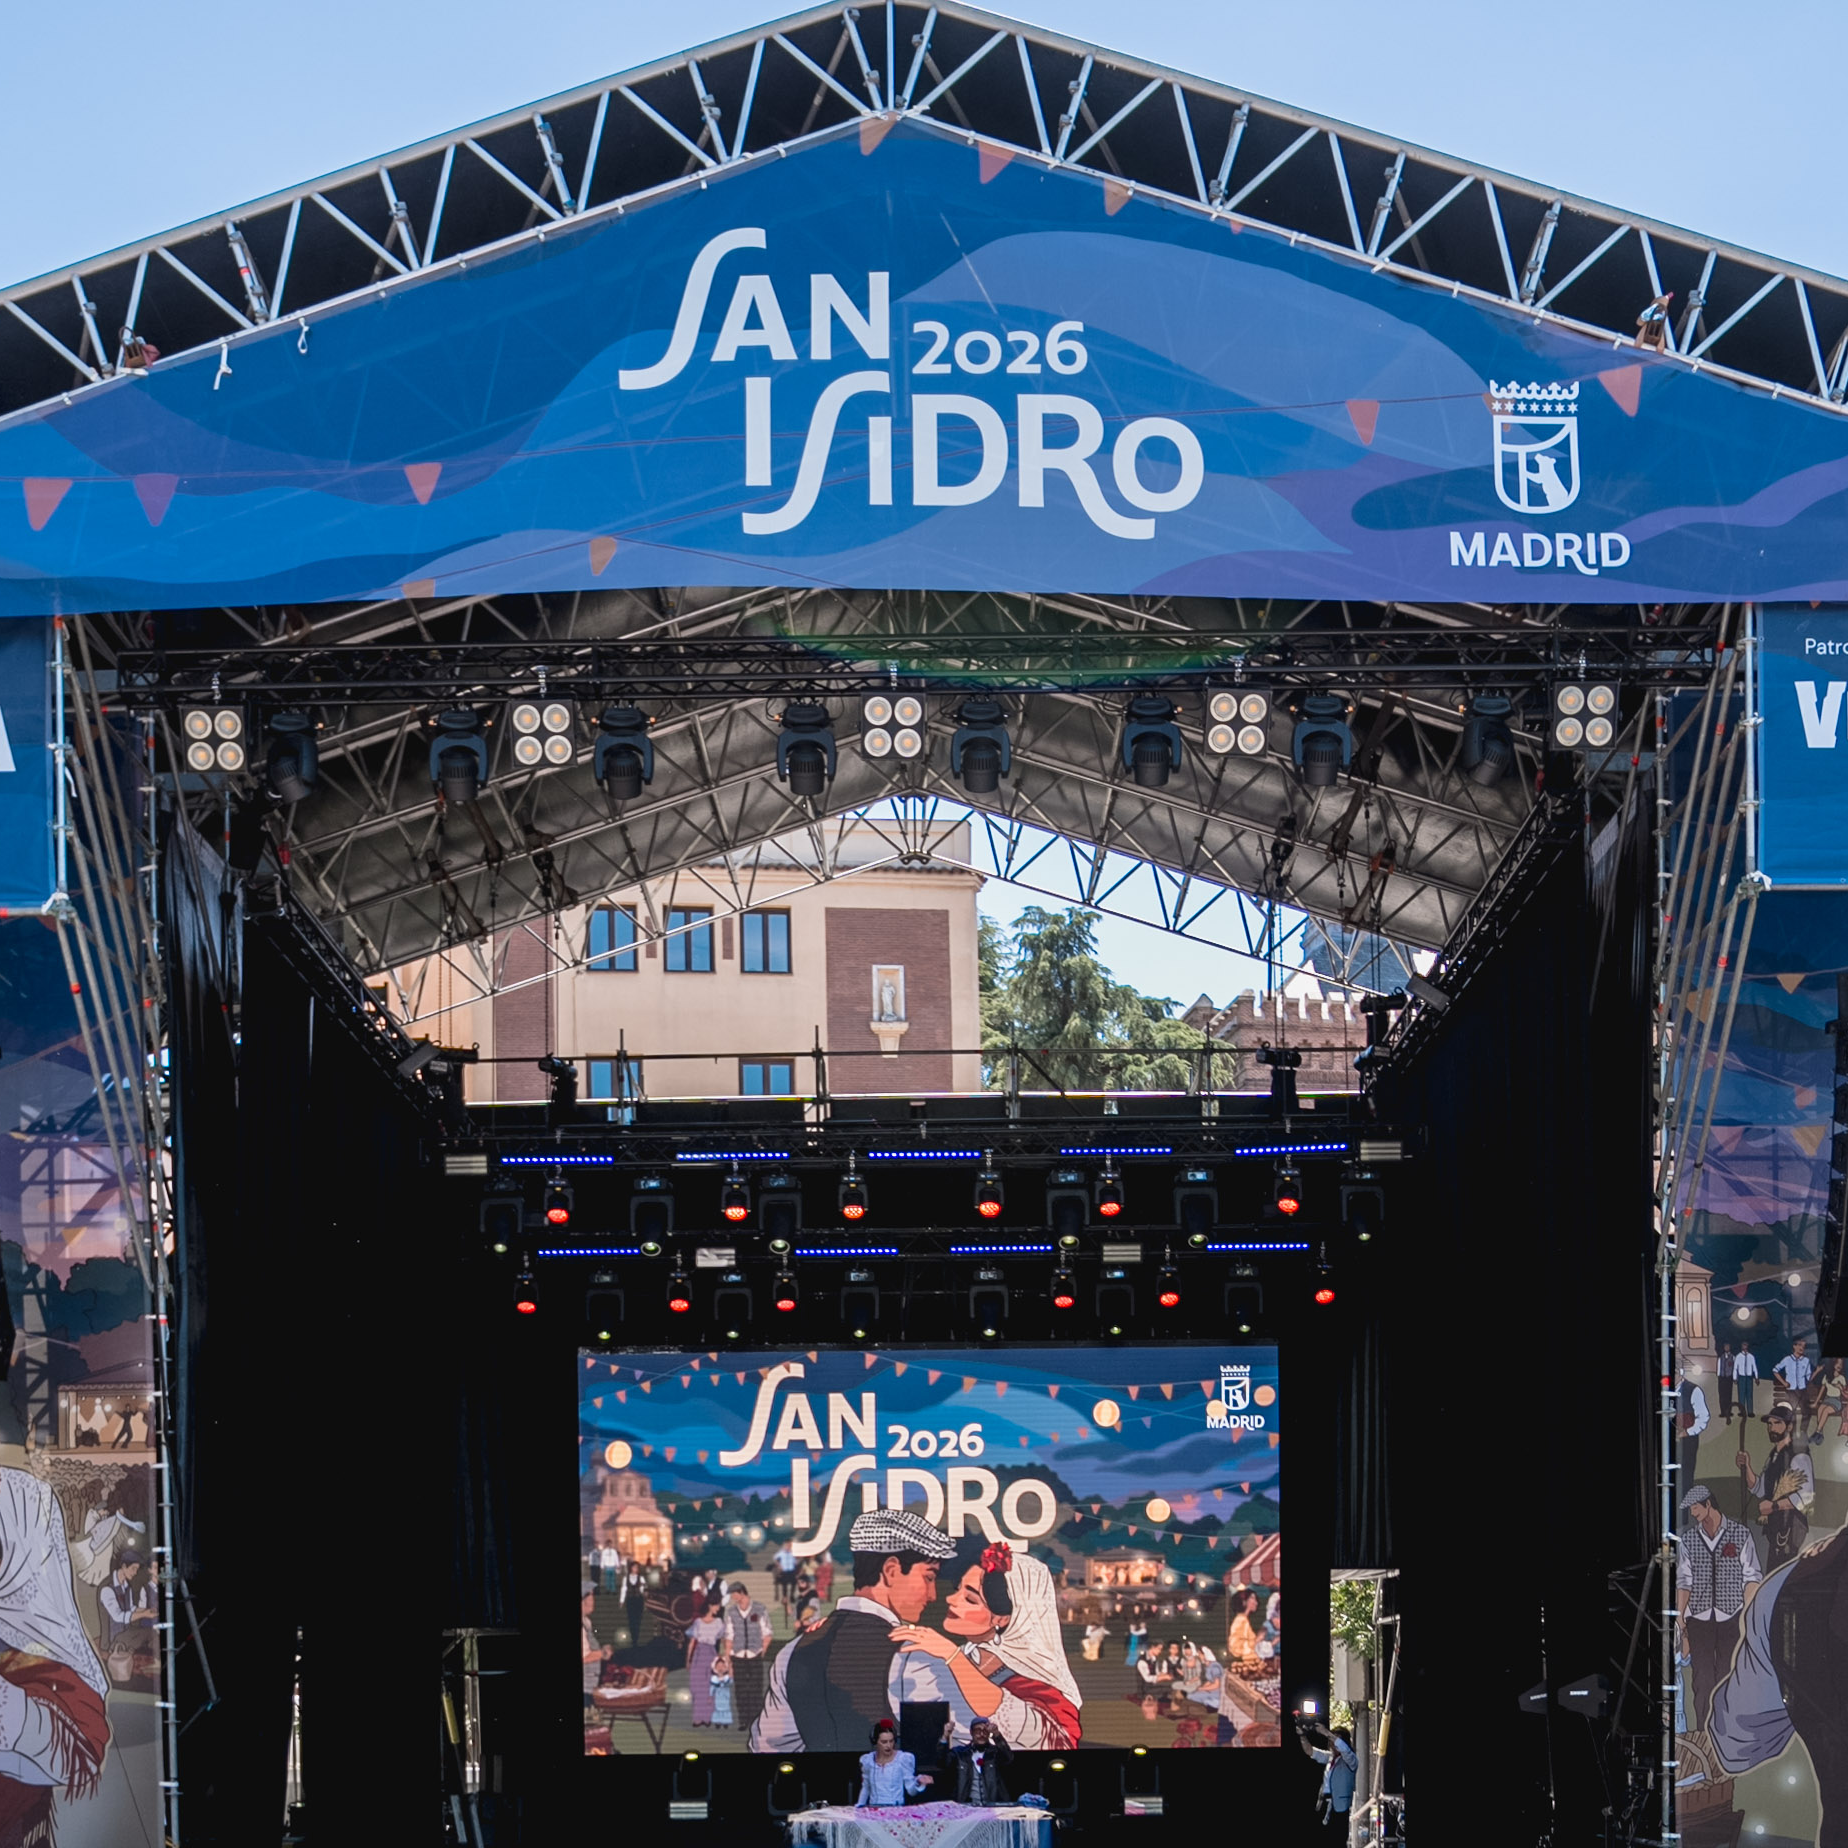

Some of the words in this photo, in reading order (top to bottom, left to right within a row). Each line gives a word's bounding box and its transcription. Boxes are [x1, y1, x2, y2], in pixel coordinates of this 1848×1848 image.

[619, 227, 889, 389] SAN
[912, 320, 1087, 376] 2026
[743, 371, 1204, 540] ISIDRO
[1450, 531, 1630, 574] MADRID
[719, 1363, 876, 1467] SAN
[887, 1423, 985, 1458] 2026
[1206, 1414, 1265, 1431] MADRID
[790, 1454, 1057, 1557] ISIDRO
